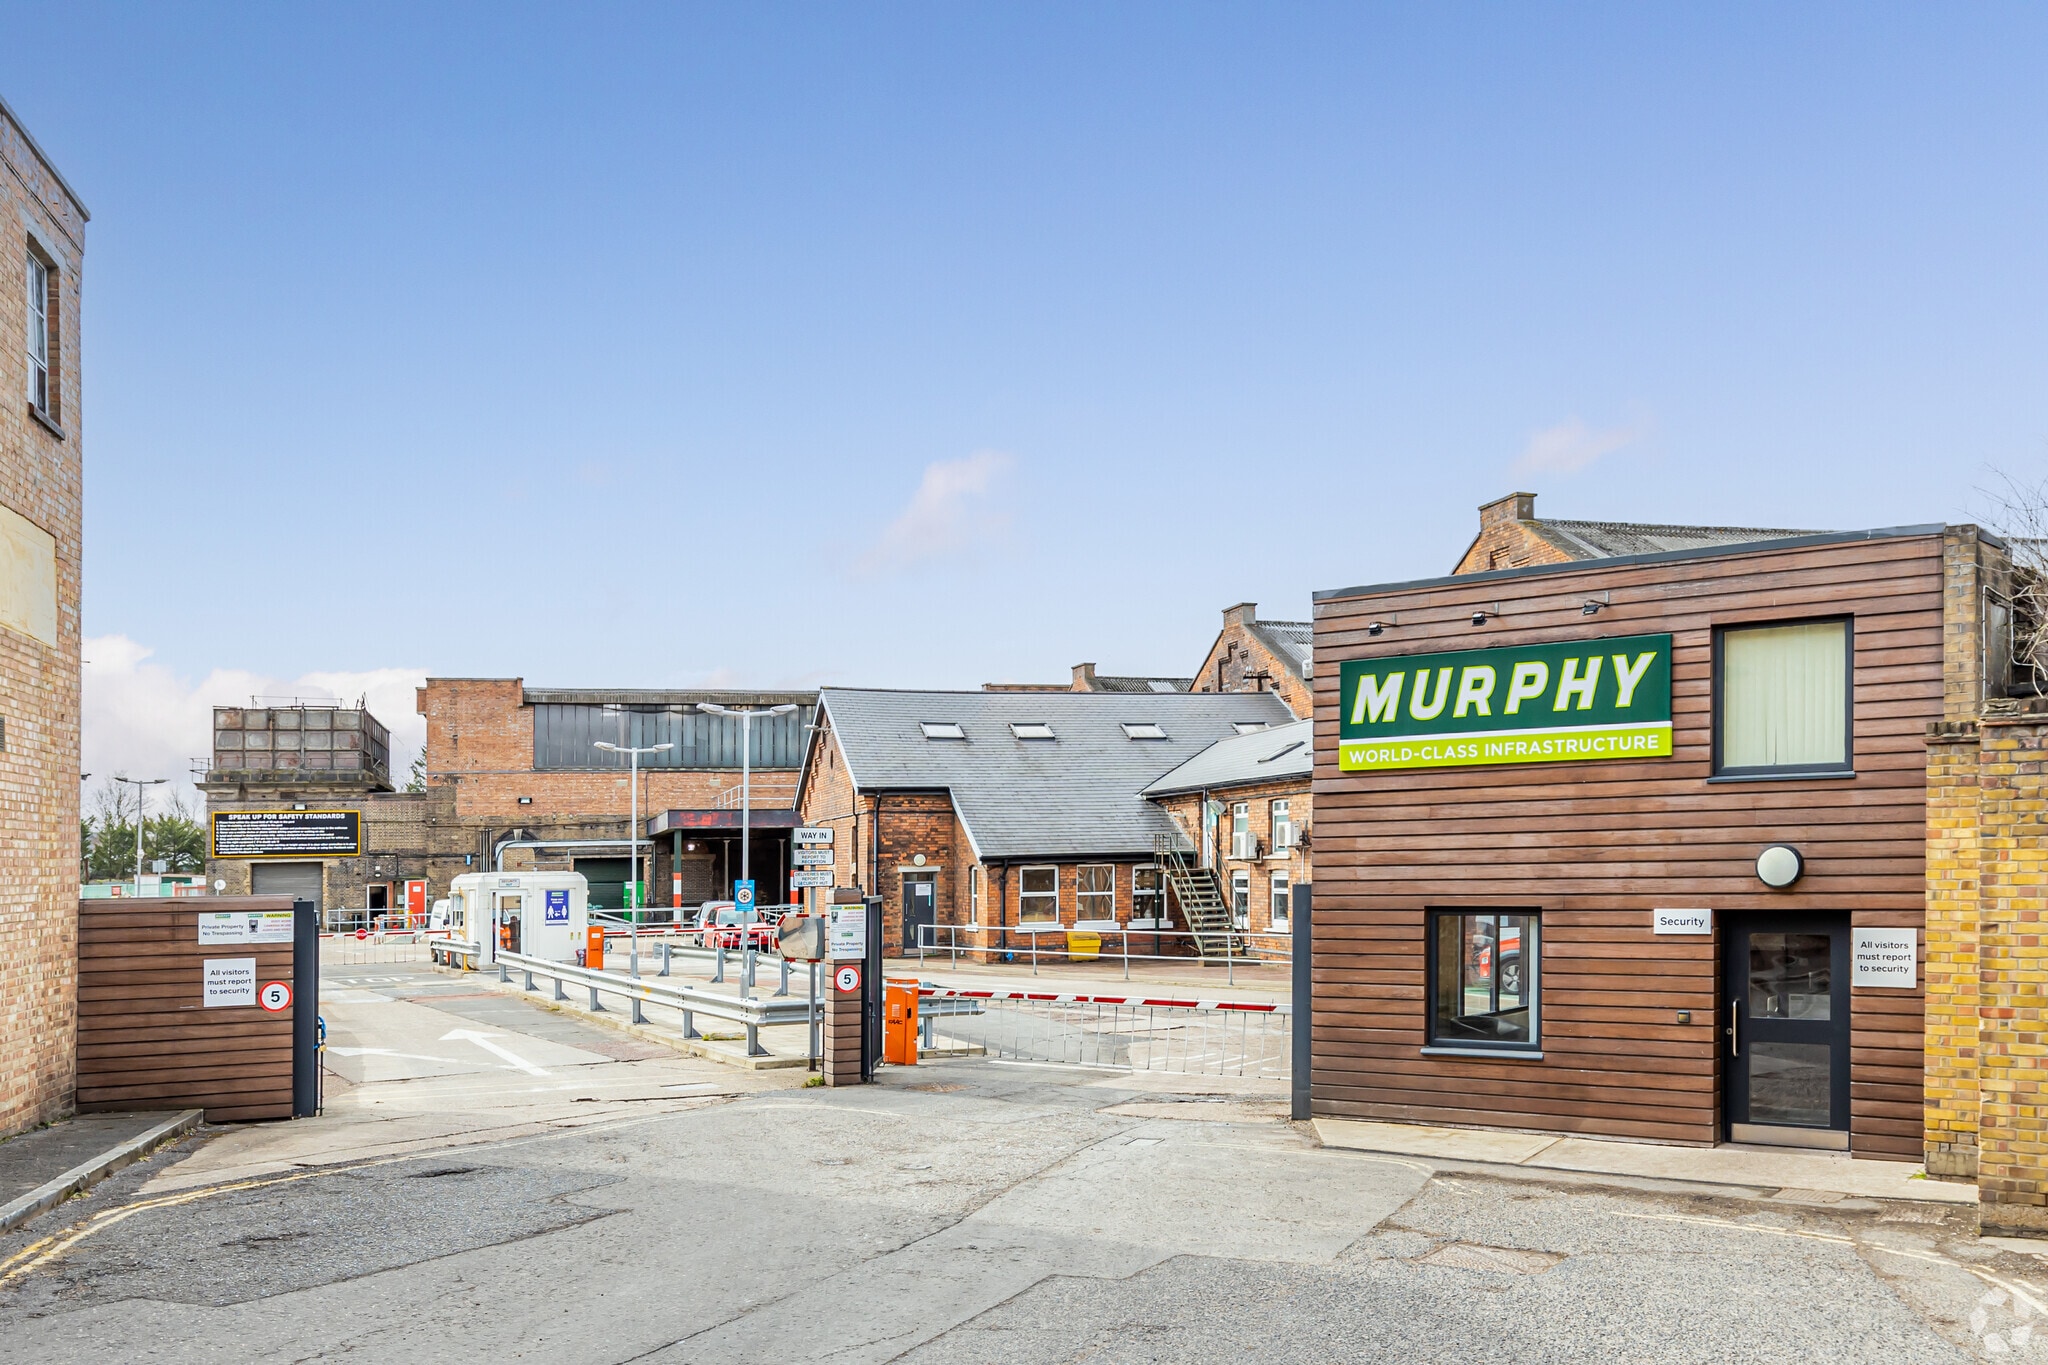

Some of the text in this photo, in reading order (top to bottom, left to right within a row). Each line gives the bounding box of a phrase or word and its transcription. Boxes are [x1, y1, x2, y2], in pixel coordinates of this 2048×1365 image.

[1350, 651, 1657, 725] MURPHY
[1348, 735, 1658, 763] WORLD-CLASS INFRASTRUCTURE
[1660, 916, 1705, 928] Security
[1861, 940, 1908, 950] All visitors
[1857, 953, 1911, 963] must report
[1860, 964, 1909, 975] to security
[228, 978, 252, 986] report
[844, 974, 851, 984] 5
[271, 991, 280, 1002] 5
